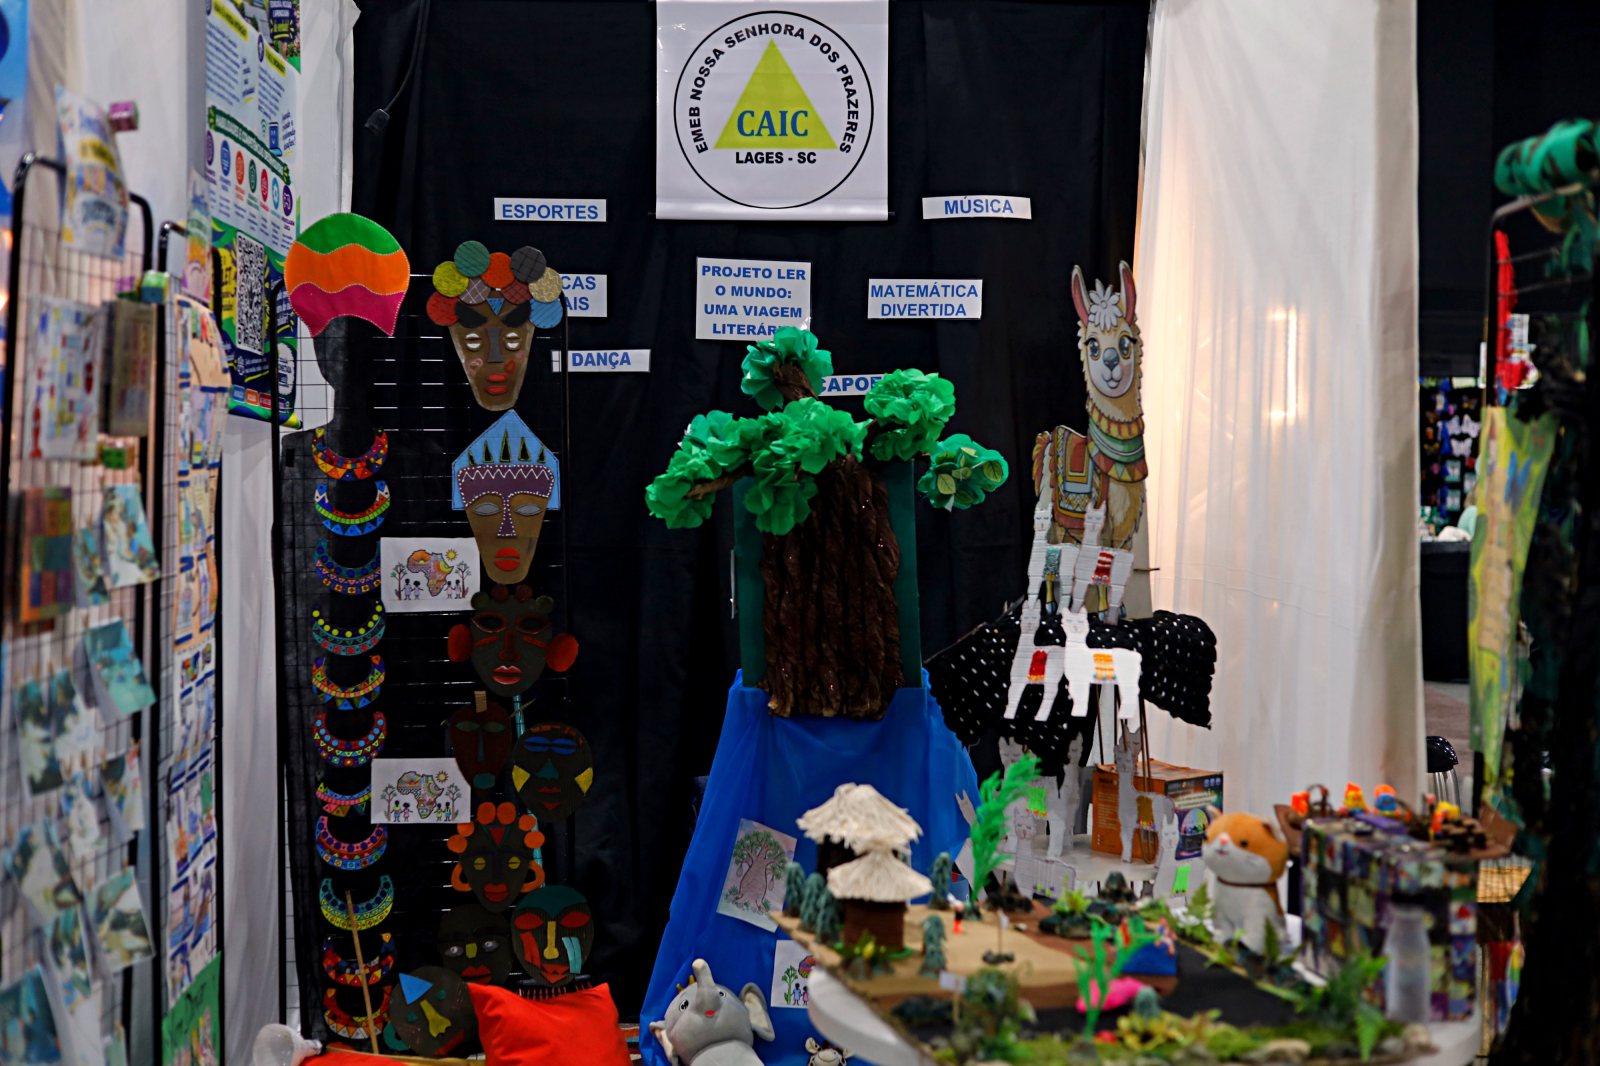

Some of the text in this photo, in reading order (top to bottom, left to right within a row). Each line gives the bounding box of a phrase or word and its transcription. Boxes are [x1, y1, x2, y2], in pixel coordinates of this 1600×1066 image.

[689, 22, 859, 154] EMEB NOSSA SENHORA DOS PRAZERES
[737, 110, 809, 137] CAIC
[735, 152, 784, 164] LAGES
[797, 152, 817, 164] SC
[502, 204, 599, 219] ESPORTES
[944, 196, 1013, 214] MÚSICA
[702, 265, 806, 280] PROJETO LER
[715, 285, 792, 299] O MUNDO:
[871, 282, 978, 297] MATEMÁTICA
[704, 304, 802, 318] UMA VIAGEM
[881, 304, 967, 317] DIVERTIDA
[712, 322, 780, 336] LITERÁR
[572, 352, 631, 369] DANÇA
